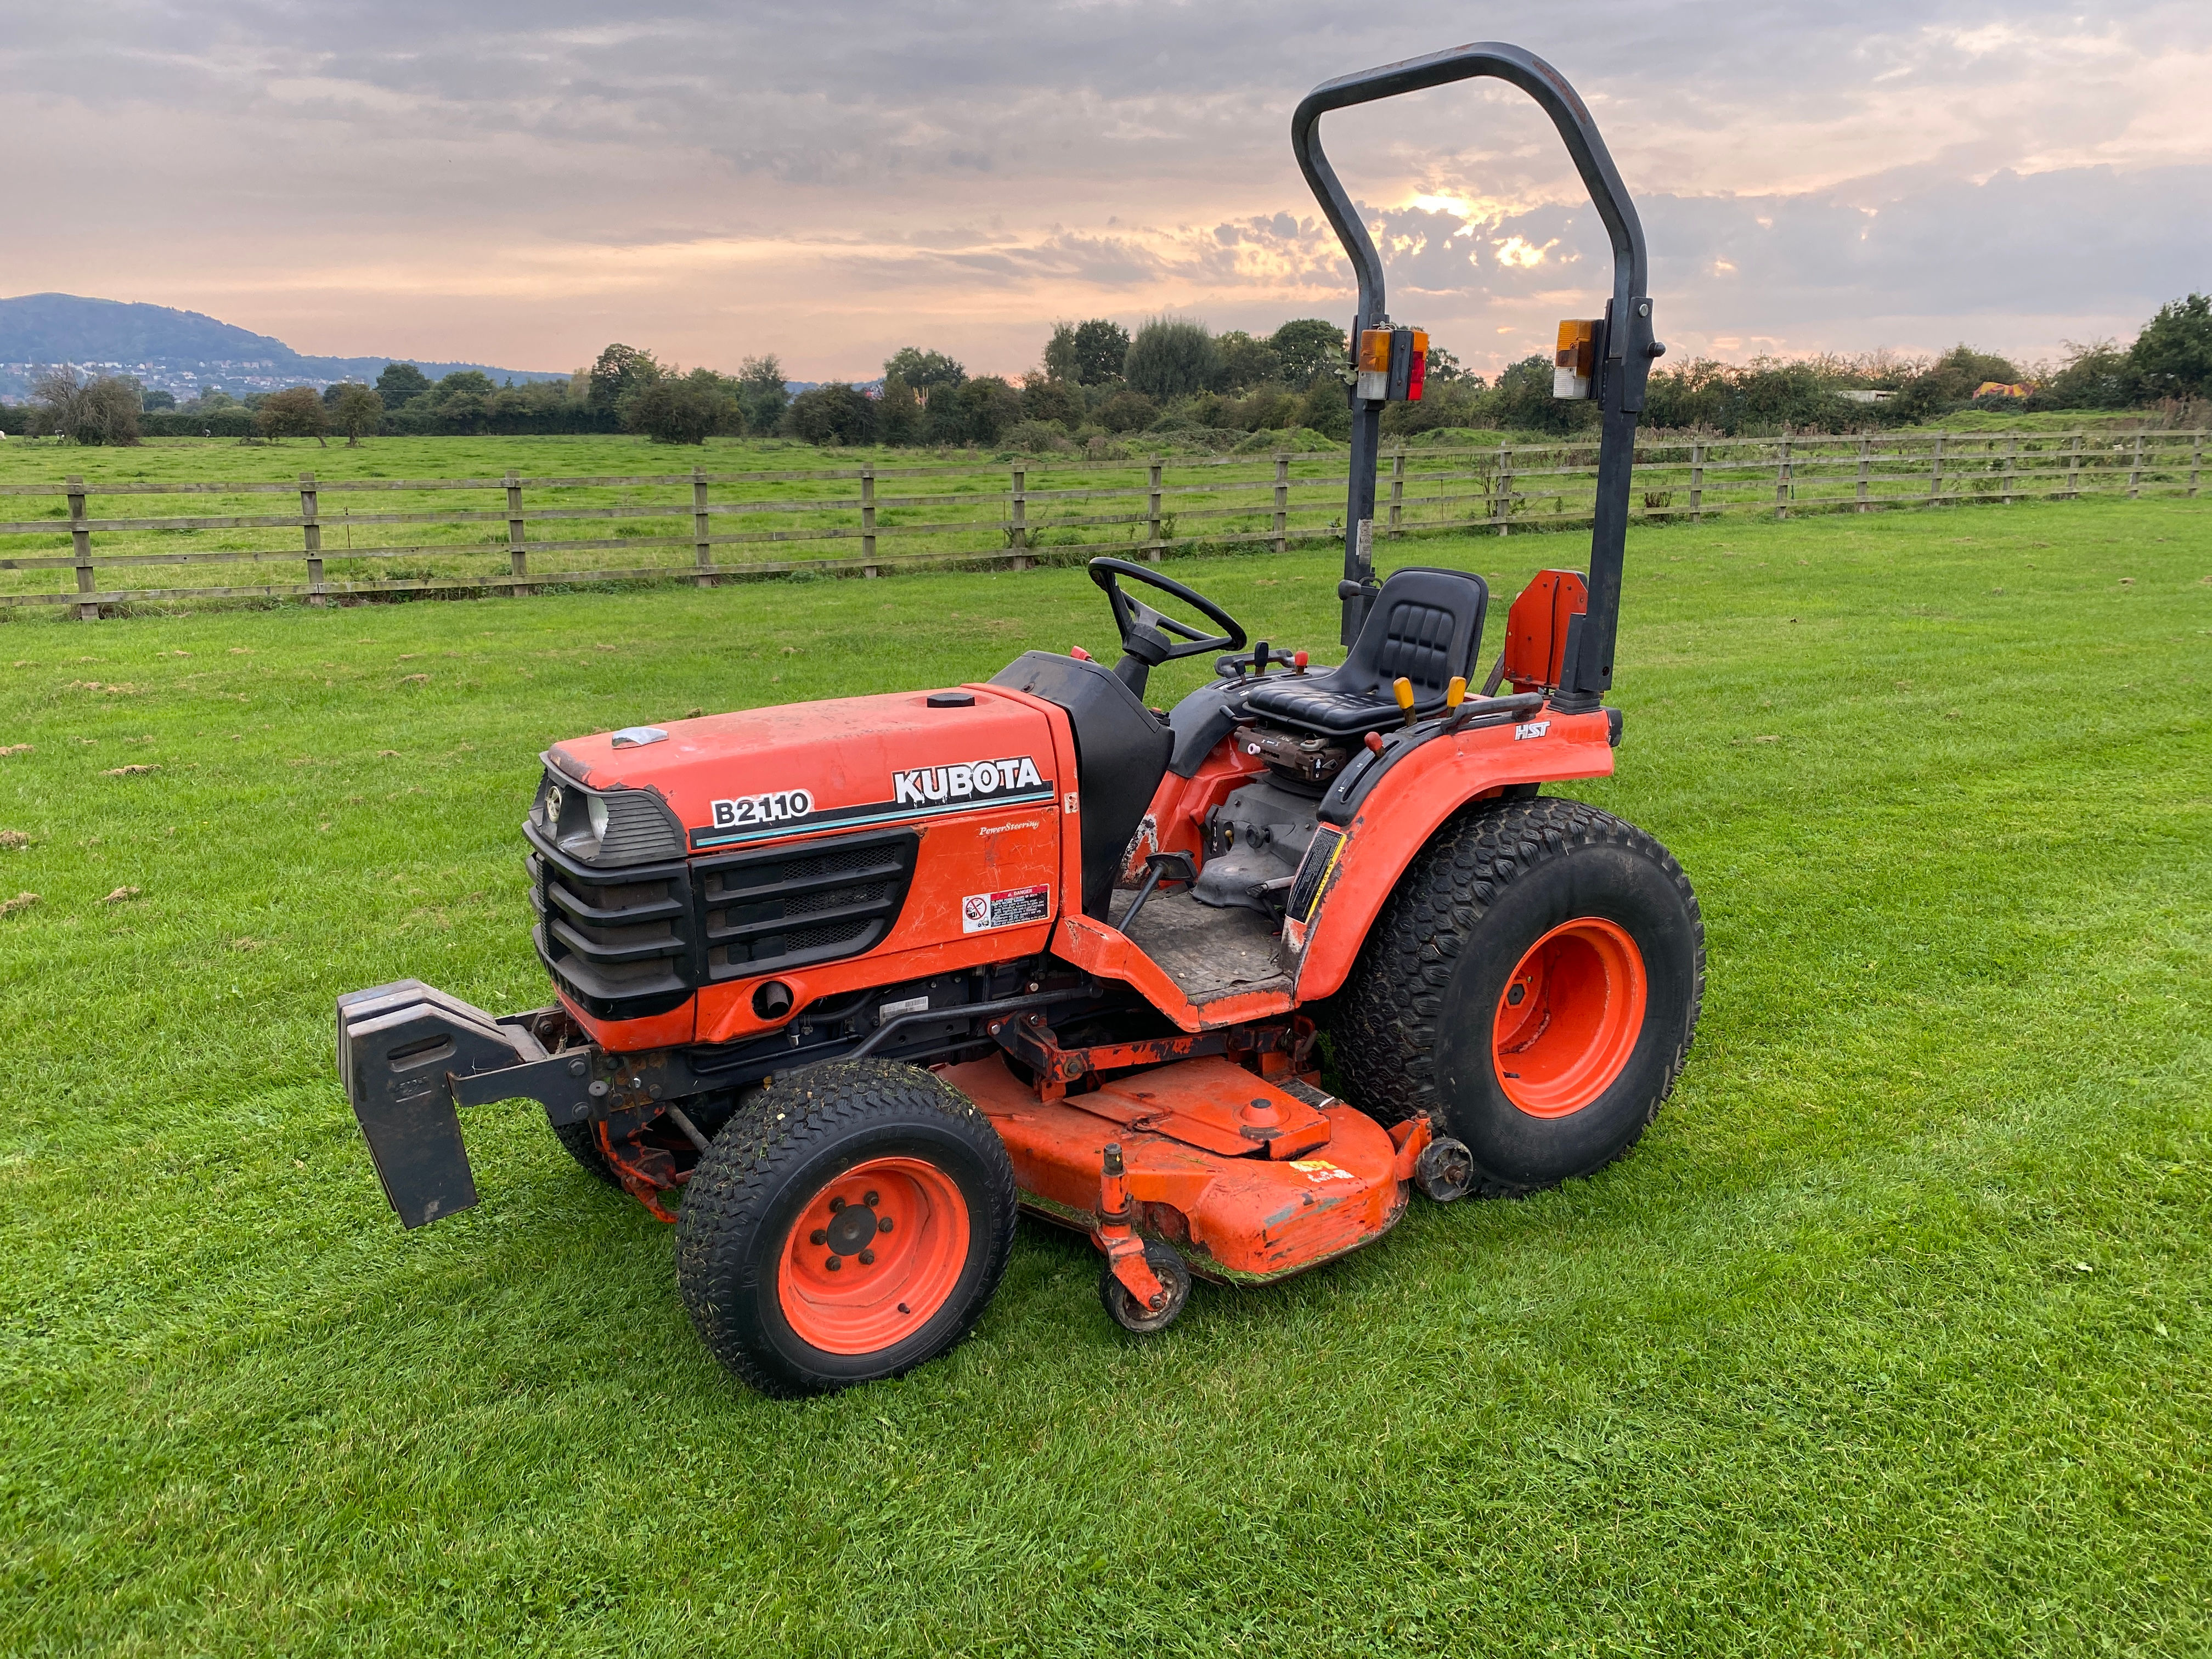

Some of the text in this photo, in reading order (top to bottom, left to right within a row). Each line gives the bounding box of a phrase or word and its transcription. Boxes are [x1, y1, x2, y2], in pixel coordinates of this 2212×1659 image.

[1515, 721, 1550, 740] HST
[894, 758, 1042, 803] KUBOTA
[715, 792, 809, 825] B2110
[1316, 866, 1331, 899] CAUTION
